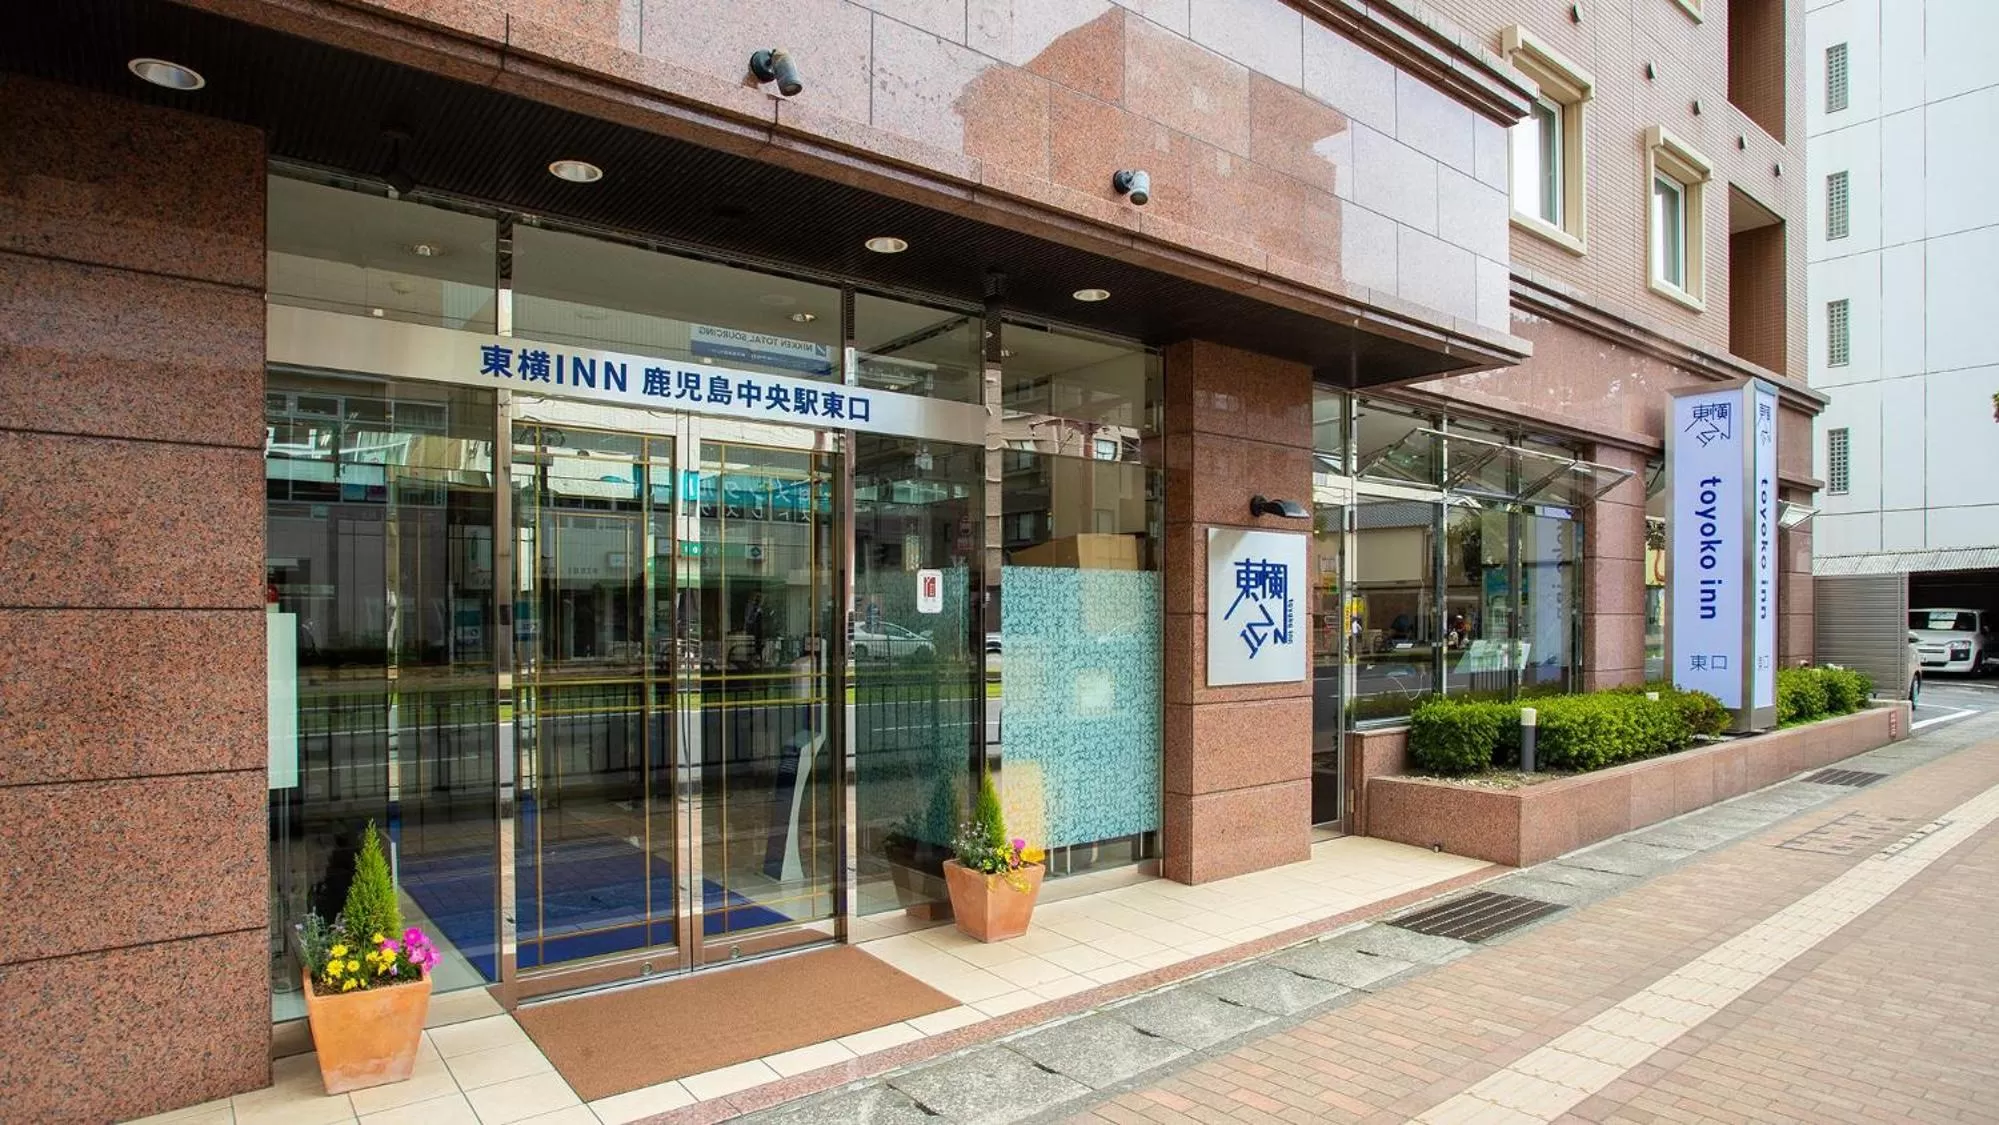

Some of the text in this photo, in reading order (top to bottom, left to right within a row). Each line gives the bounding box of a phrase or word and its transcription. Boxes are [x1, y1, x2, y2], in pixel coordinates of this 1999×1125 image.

[480, 344, 871, 422] 東横INN 鹿児島中央駅東口
[1695, 476, 1722, 620] toyoko inn
[1689, 655, 1728, 671] 東口
